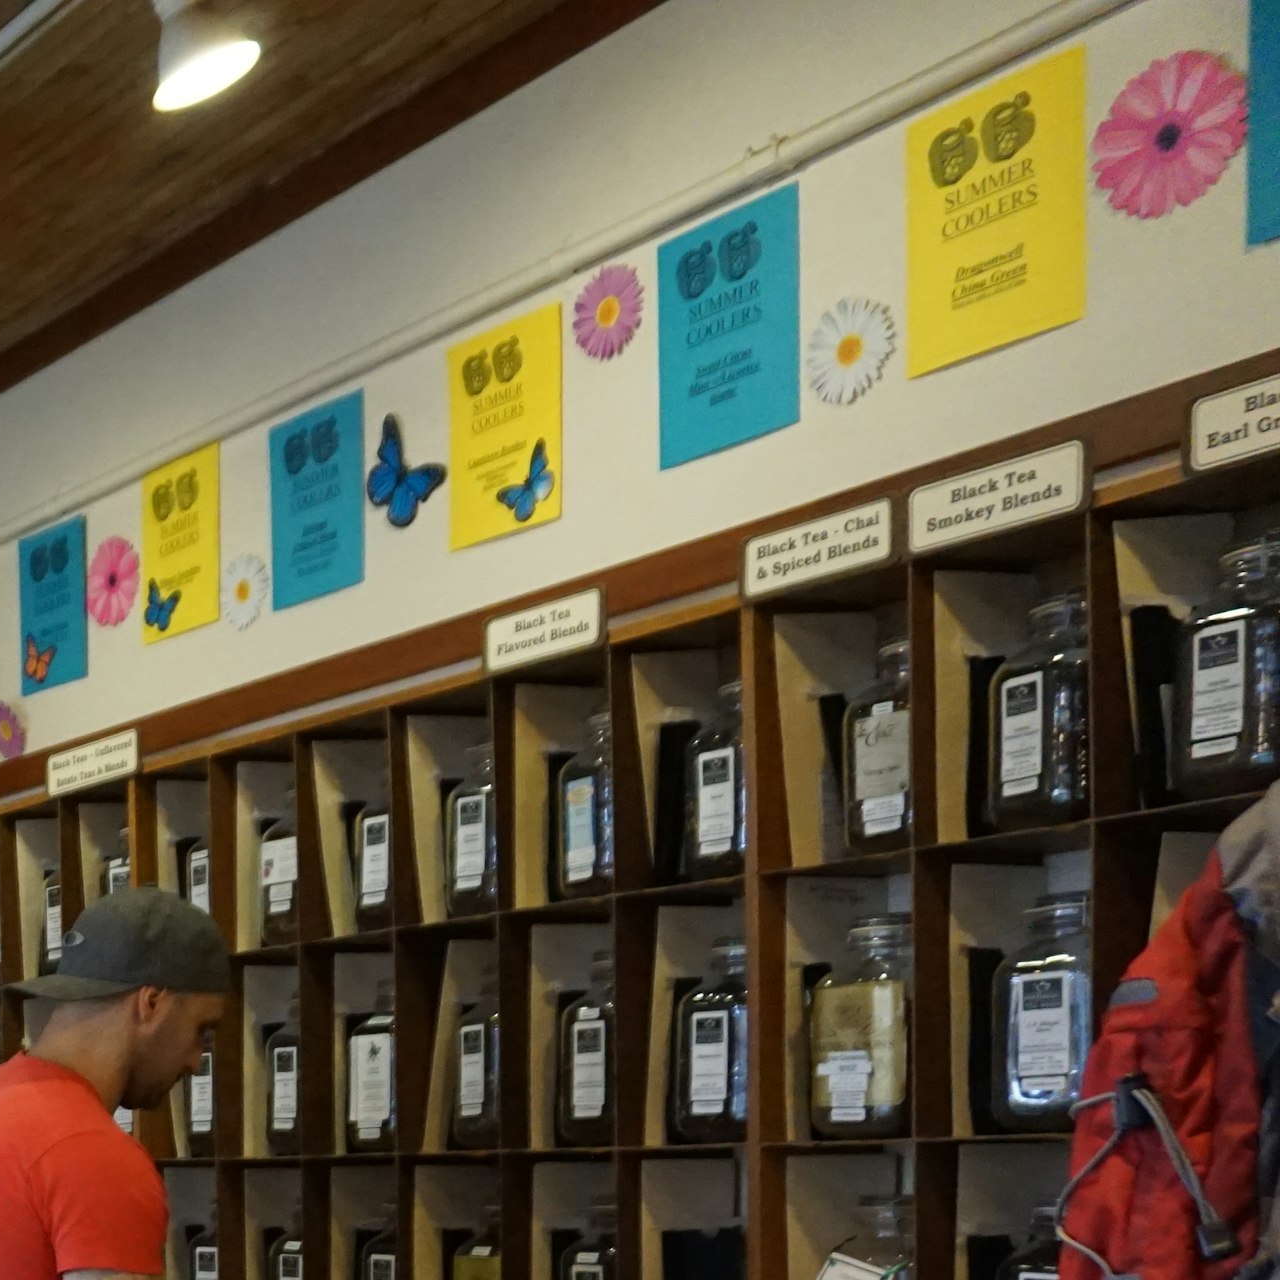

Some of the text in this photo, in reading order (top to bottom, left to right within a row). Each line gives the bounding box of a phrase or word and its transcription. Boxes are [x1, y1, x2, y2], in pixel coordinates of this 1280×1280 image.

[945, 158, 1034, 209] SUMMER
[942, 183, 1039, 238] COOLERS
[955, 242, 1024, 279] Dragonwell
[689, 279, 759, 318] SUMMER
[952, 278, 987, 299] China
[990, 262, 1028, 284] Green
[686, 302, 763, 345] COOLERS
[473, 383, 523, 412] SUMMER
[1244, 392, 1280, 413] Bla
[471, 401, 525, 433] COOLERS
[1207, 416, 1280, 450] Earl Gr
[950, 469, 1038, 504] Black Tea
[926, 483, 1063, 533] Smokey Blends
[756, 536, 797, 560] Black
[801, 529, 829, 546] Tea
[843, 511, 880, 533] Chai
[756, 534, 880, 580] & Spiced Blends
[497, 620, 590, 656] Flavored Blends
[514, 608, 572, 633] Black Tea
[52, 757, 70, 771] Black
[72, 753, 88, 764] Teas
[95, 737, 133, 757] Unflavored
